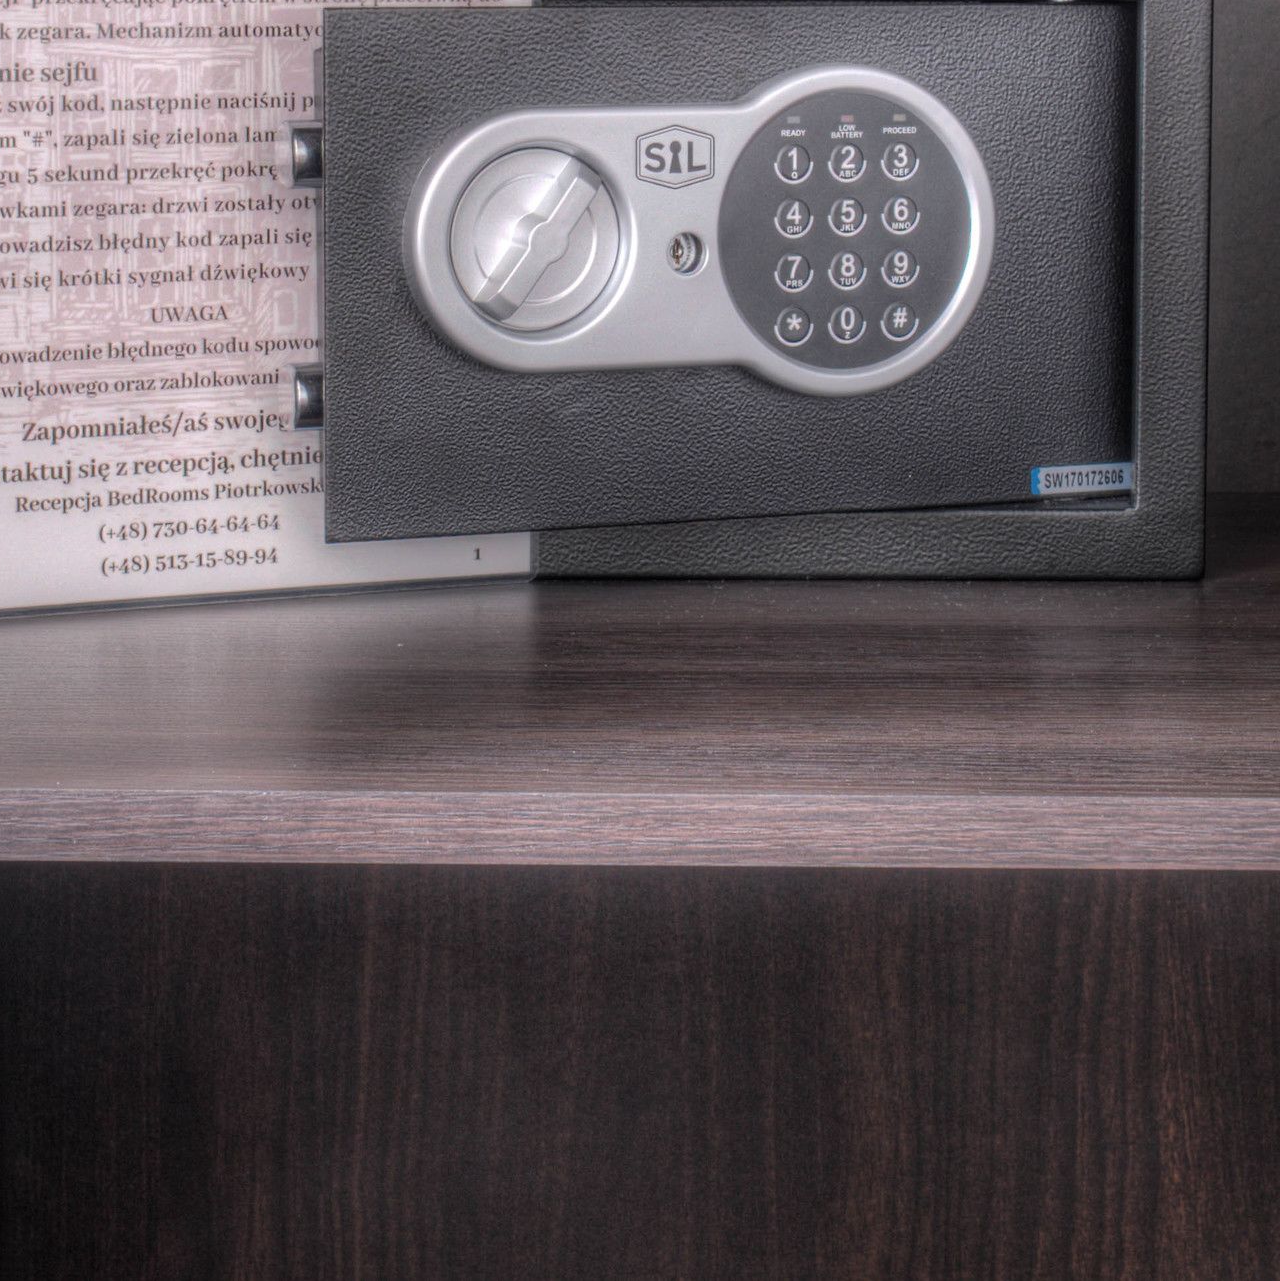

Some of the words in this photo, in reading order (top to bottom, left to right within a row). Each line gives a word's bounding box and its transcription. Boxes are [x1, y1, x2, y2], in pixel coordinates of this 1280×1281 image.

[17, 27, 91, 43] zegara.
[97, 22, 212, 39] Mechanizm
[41, 62, 97, 86] sejfu
[8, 97, 54, 115] swój
[62, 95, 105, 113] kod,
[111, 94, 211, 114] następnie
[217, 93, 295, 110] naciśnij
[64, 129, 125, 149] zapali
[132, 130, 160, 149] się
[166, 129, 238, 144] zielona
[788, 147, 797, 170] 1
[841, 146, 855, 168] 2
[894, 144, 908, 168] 3
[27, 169, 38, 184] 5
[45, 163, 119, 182] sekund
[127, 163, 215, 183] przekręć
[73, 204, 146, 218] zegara:
[153, 197, 208, 214] drzwi
[215, 194, 284, 213] zostały
[787, 201, 801, 224] 4
[841, 200, 855, 223] 5
[894, 198, 908, 221] 6
[99, 234, 169, 252] błędny
[176, 232, 212, 248] kod
[219, 229, 278, 251] zapali
[285, 228, 312, 246] się
[23, 271, 52, 292] się
[59, 270, 120, 286] krótki
[128, 266, 193, 287] sygnał
[200, 262, 310, 282] dźwiękowy
[788, 256, 802, 279] 7
[841, 254, 855, 277] 8
[894, 251, 908, 274] 9
[152, 305, 228, 324] UWAGA
[841, 307, 855, 330] 0
[893, 307, 907, 328] #
[108, 341, 196, 361] błędnego
[203, 337, 249, 353] kodu
[114, 377, 156, 392] oraz
[22, 411, 208, 445] Zapomniałeś/aś
[78, 459, 110, 481] się
[117, 462, 127, 476] z
[134, 452, 234, 478] recepcją,
[241, 446, 322, 469] chętnie
[1045, 469, 1124, 488] SW170172606
[16, 492, 102, 514] Recepcja
[108, 486, 209, 507] BedRooms
[99, 523, 147, 544] (+48)
[153, 514, 279, 539] 730-64-64-64
[101, 556, 149, 578] (+48)
[156, 547, 278, 573] 513-15-89-94
